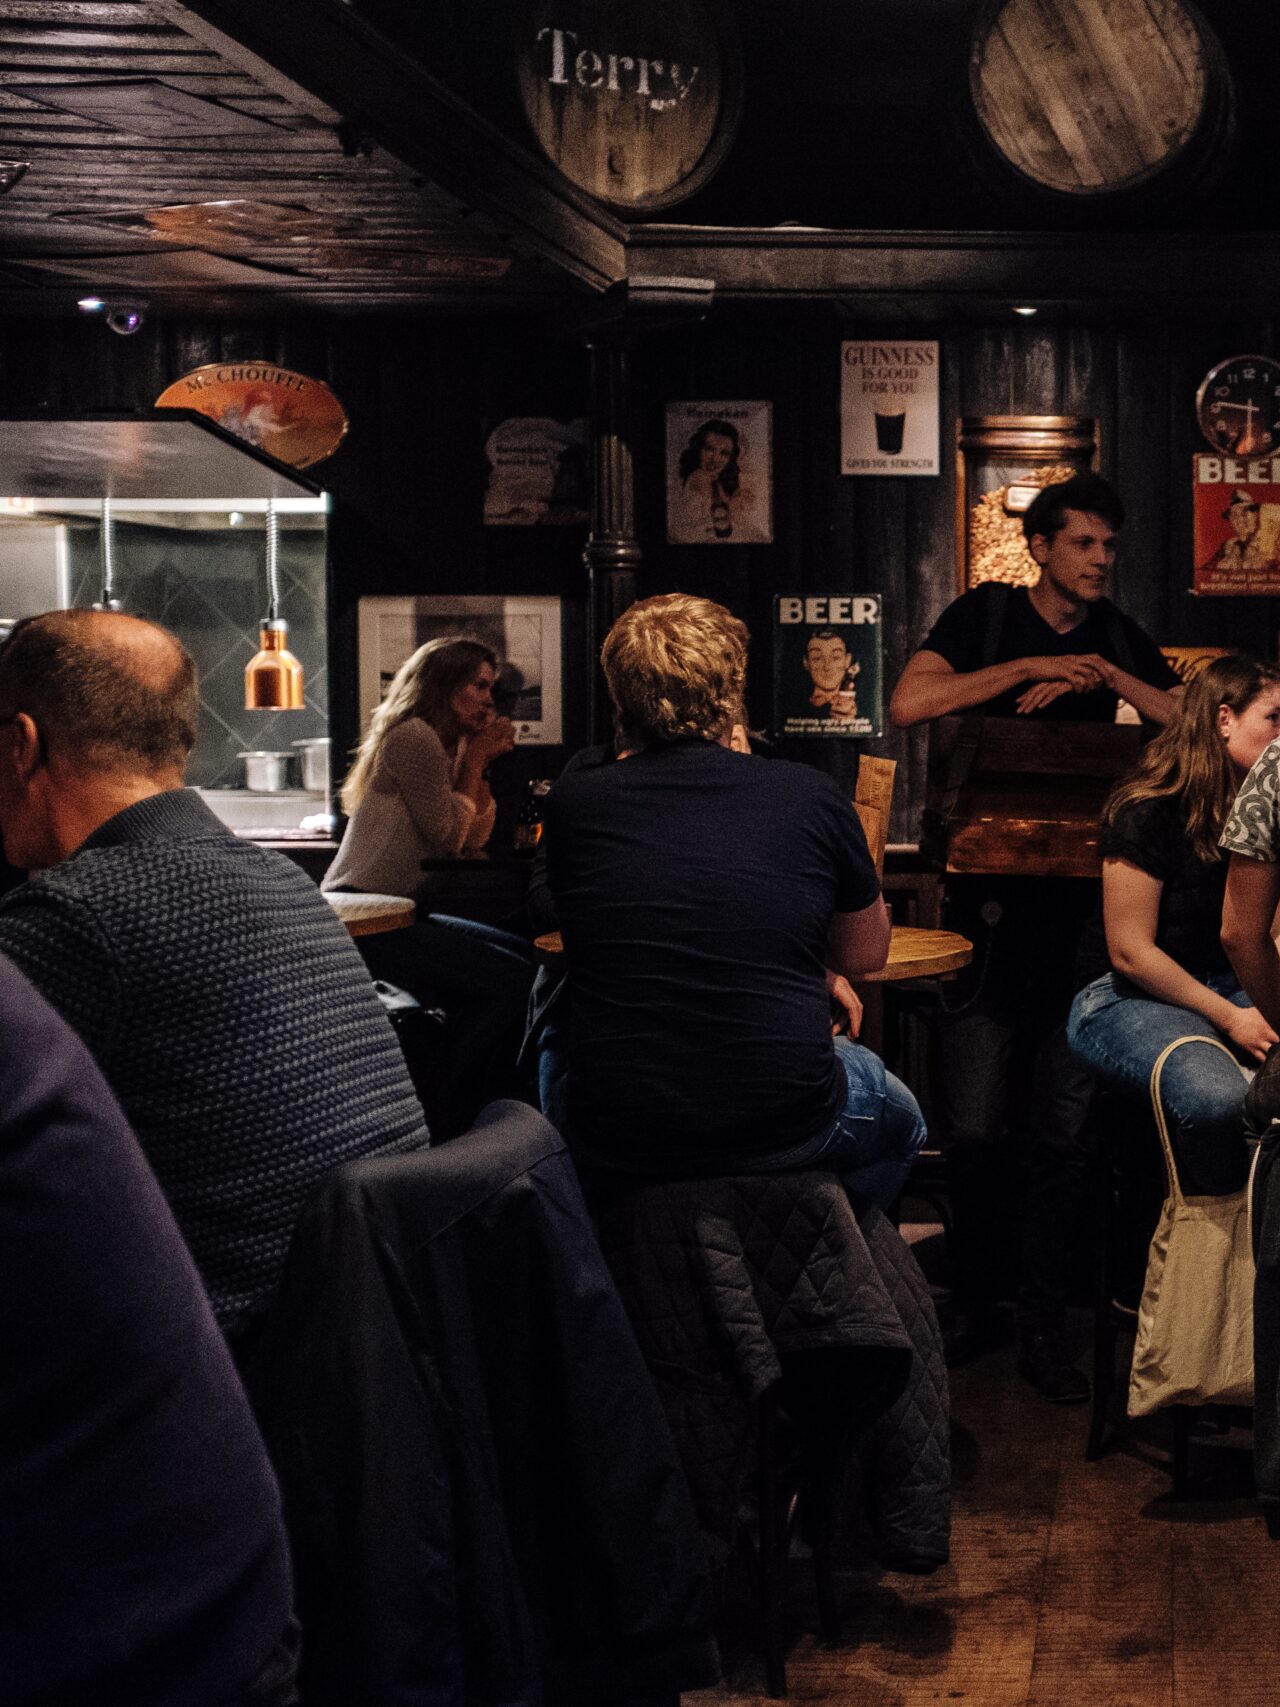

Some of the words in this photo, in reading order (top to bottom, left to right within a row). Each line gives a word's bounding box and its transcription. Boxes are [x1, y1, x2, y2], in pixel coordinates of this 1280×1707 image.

[537, 27, 699, 111] Terry
[844, 346, 934, 366] GUINNESS
[878, 367, 919, 380] GOOD
[779, 597, 879, 625] BEER
